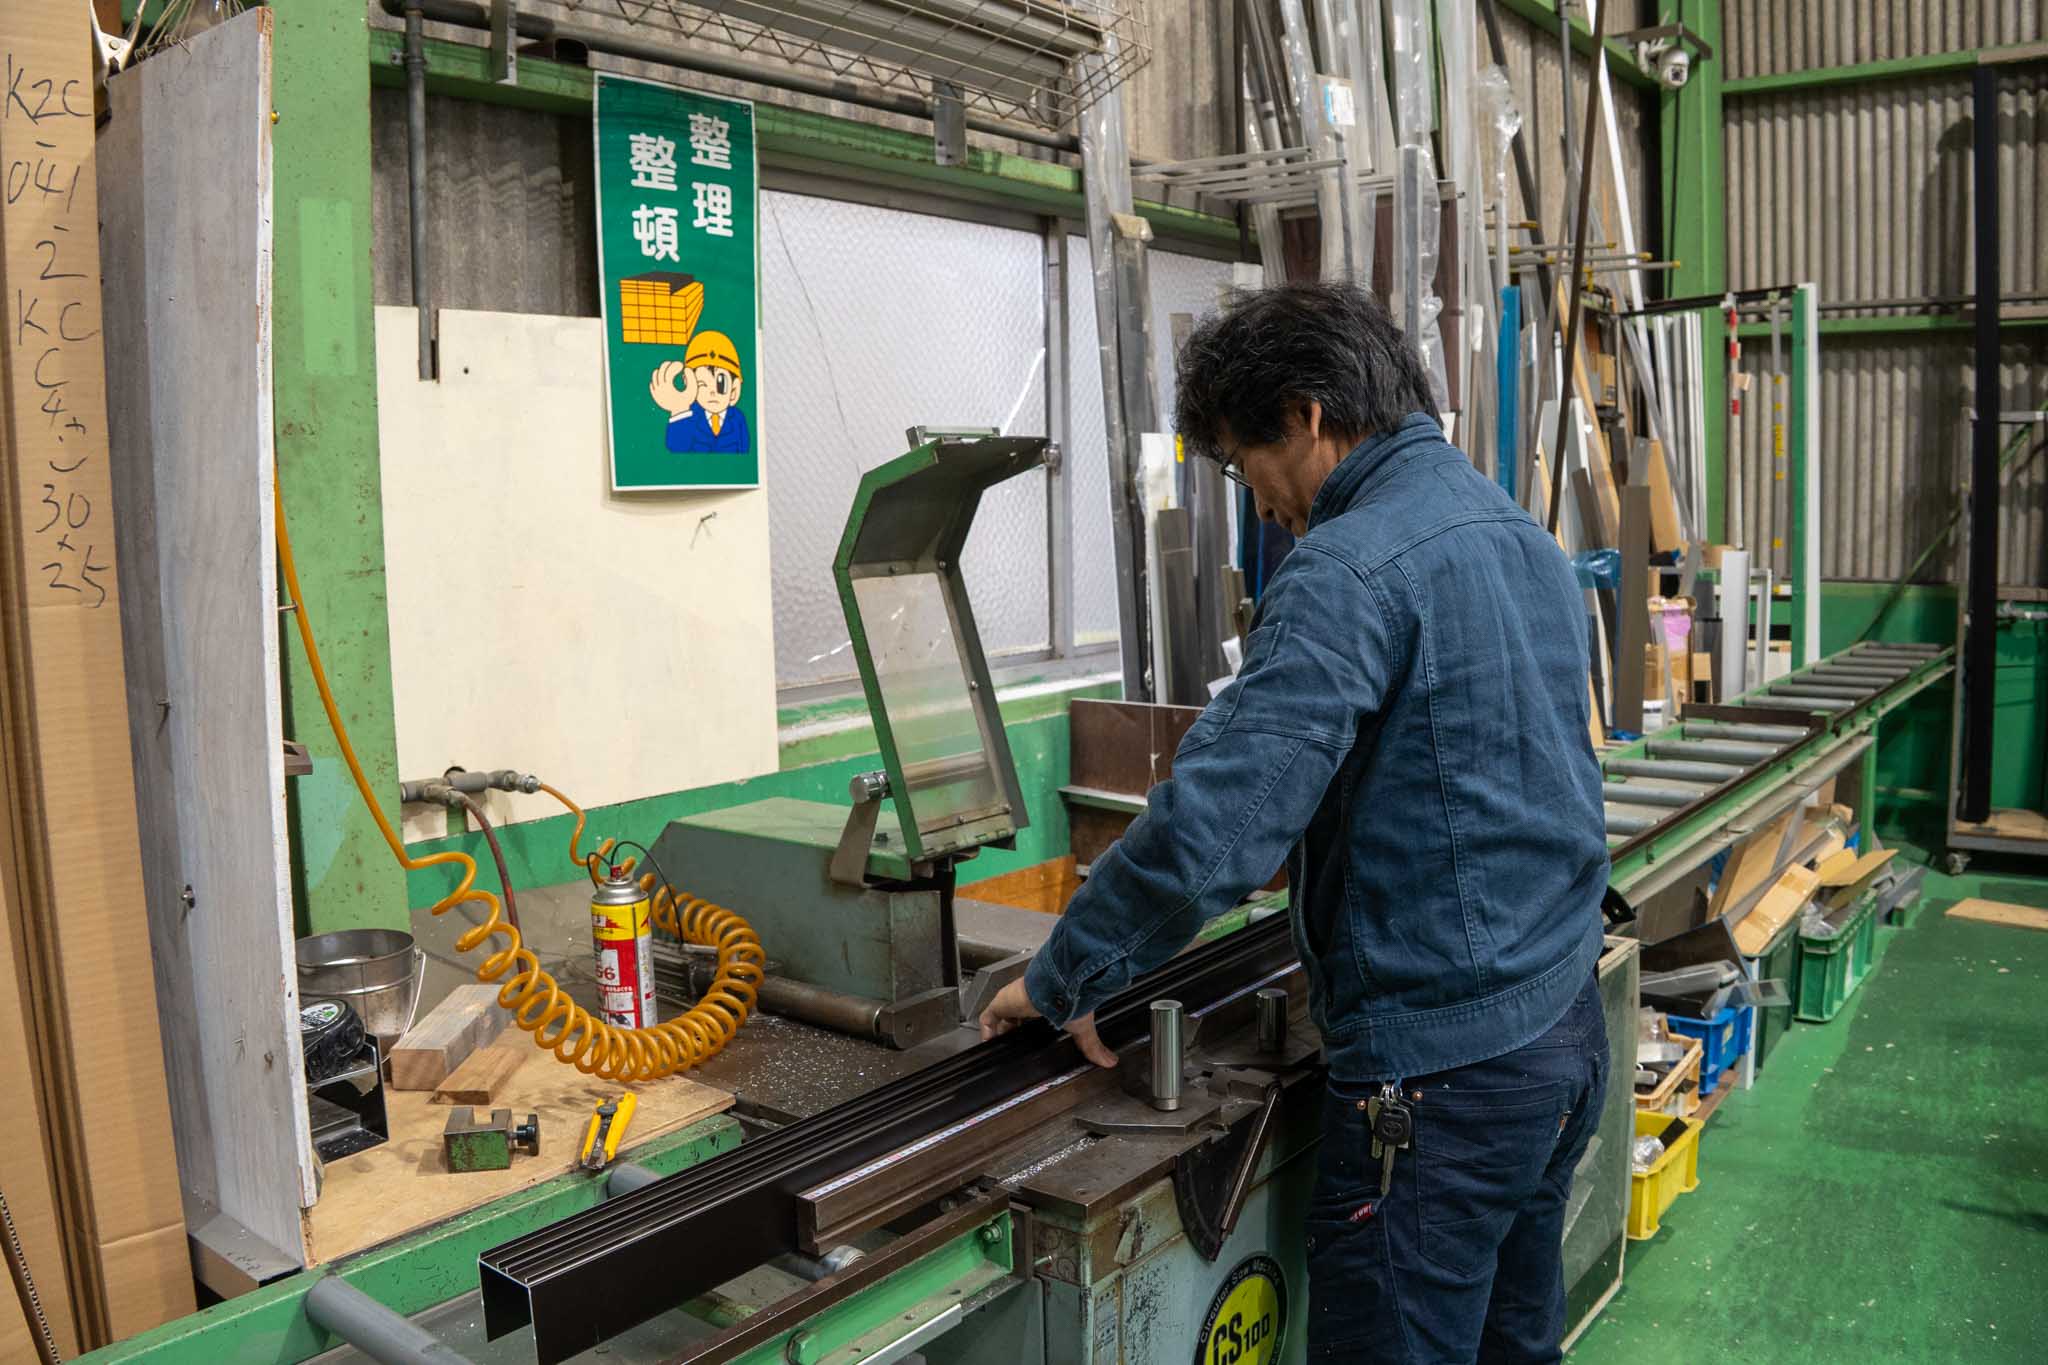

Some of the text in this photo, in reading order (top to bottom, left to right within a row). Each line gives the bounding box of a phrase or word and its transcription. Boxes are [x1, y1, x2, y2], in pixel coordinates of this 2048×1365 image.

[6, 53, 93, 126] K2C
[628, 132, 681, 263] 整頓
[688, 112, 733, 237] 整理
[35, 483, 91, 533] 30
[41, 544, 110, 609] 25
[1200, 1284, 1232, 1344] Circular
